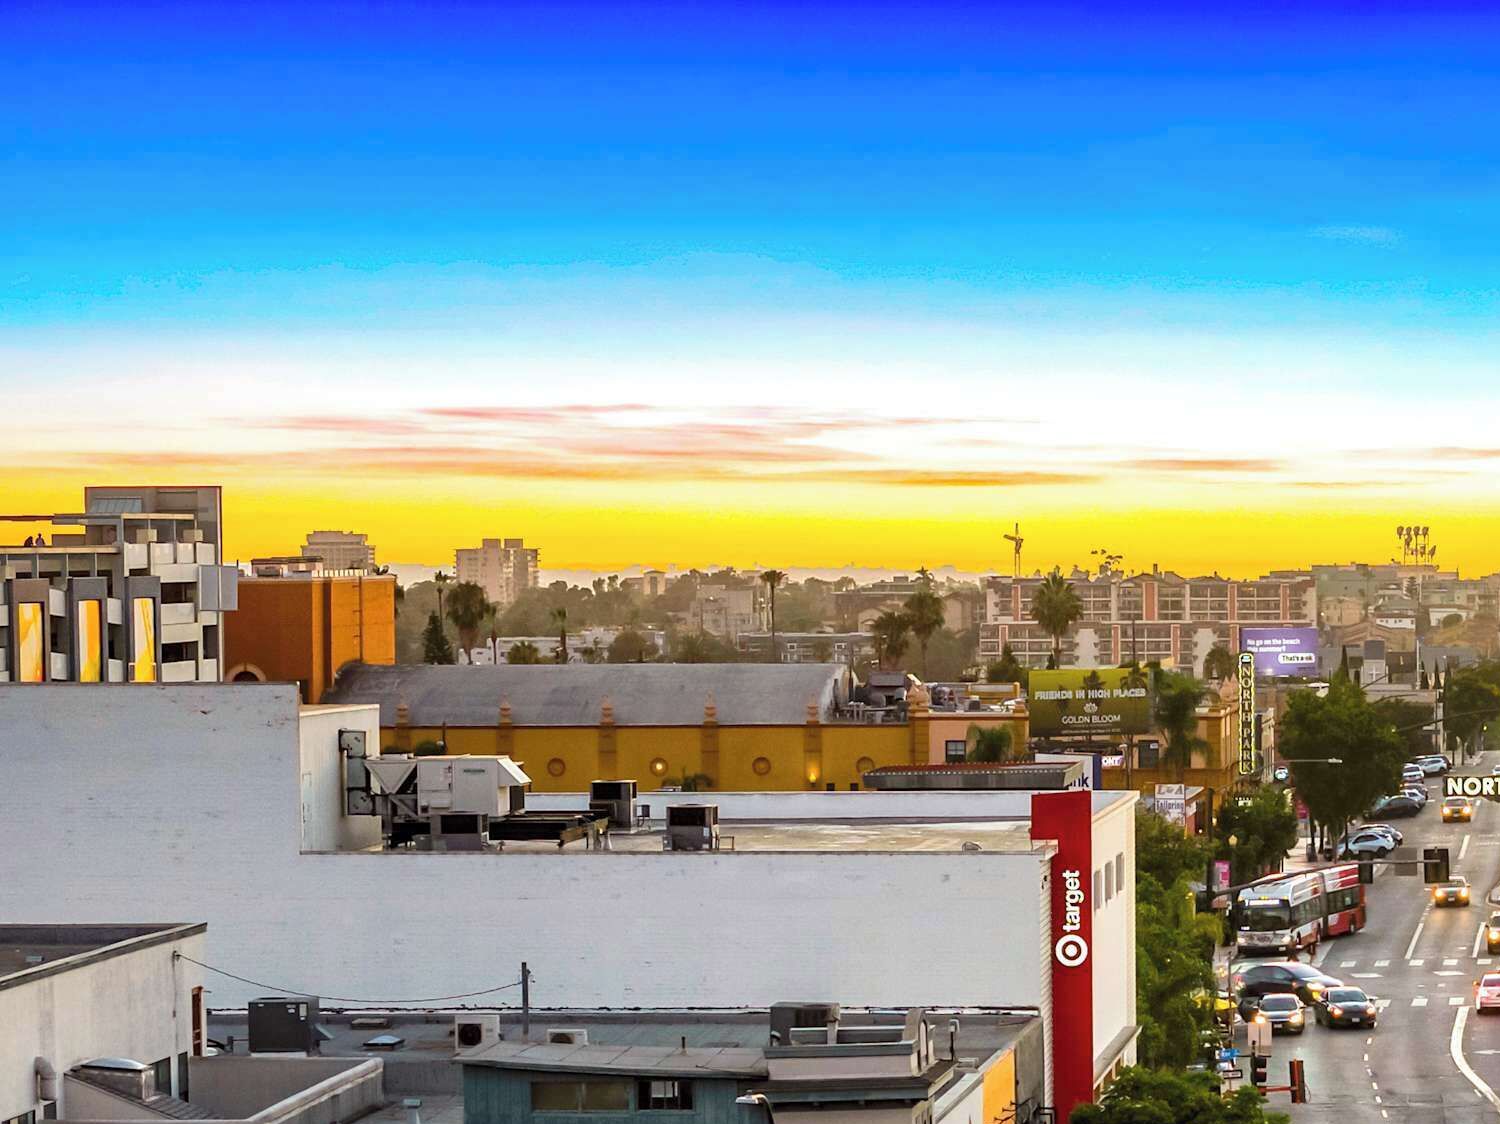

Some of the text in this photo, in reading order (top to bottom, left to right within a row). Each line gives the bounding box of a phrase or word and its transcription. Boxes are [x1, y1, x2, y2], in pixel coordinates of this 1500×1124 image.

[1035, 687, 1147, 700] FRIENDS IN HIGH PLACES
[1241, 664, 1252, 722] NORTH
[1062, 714, 1121, 725] GOLDN BLOOM
[1242, 727, 1252, 772] PARK
[1062, 869, 1085, 933] target
